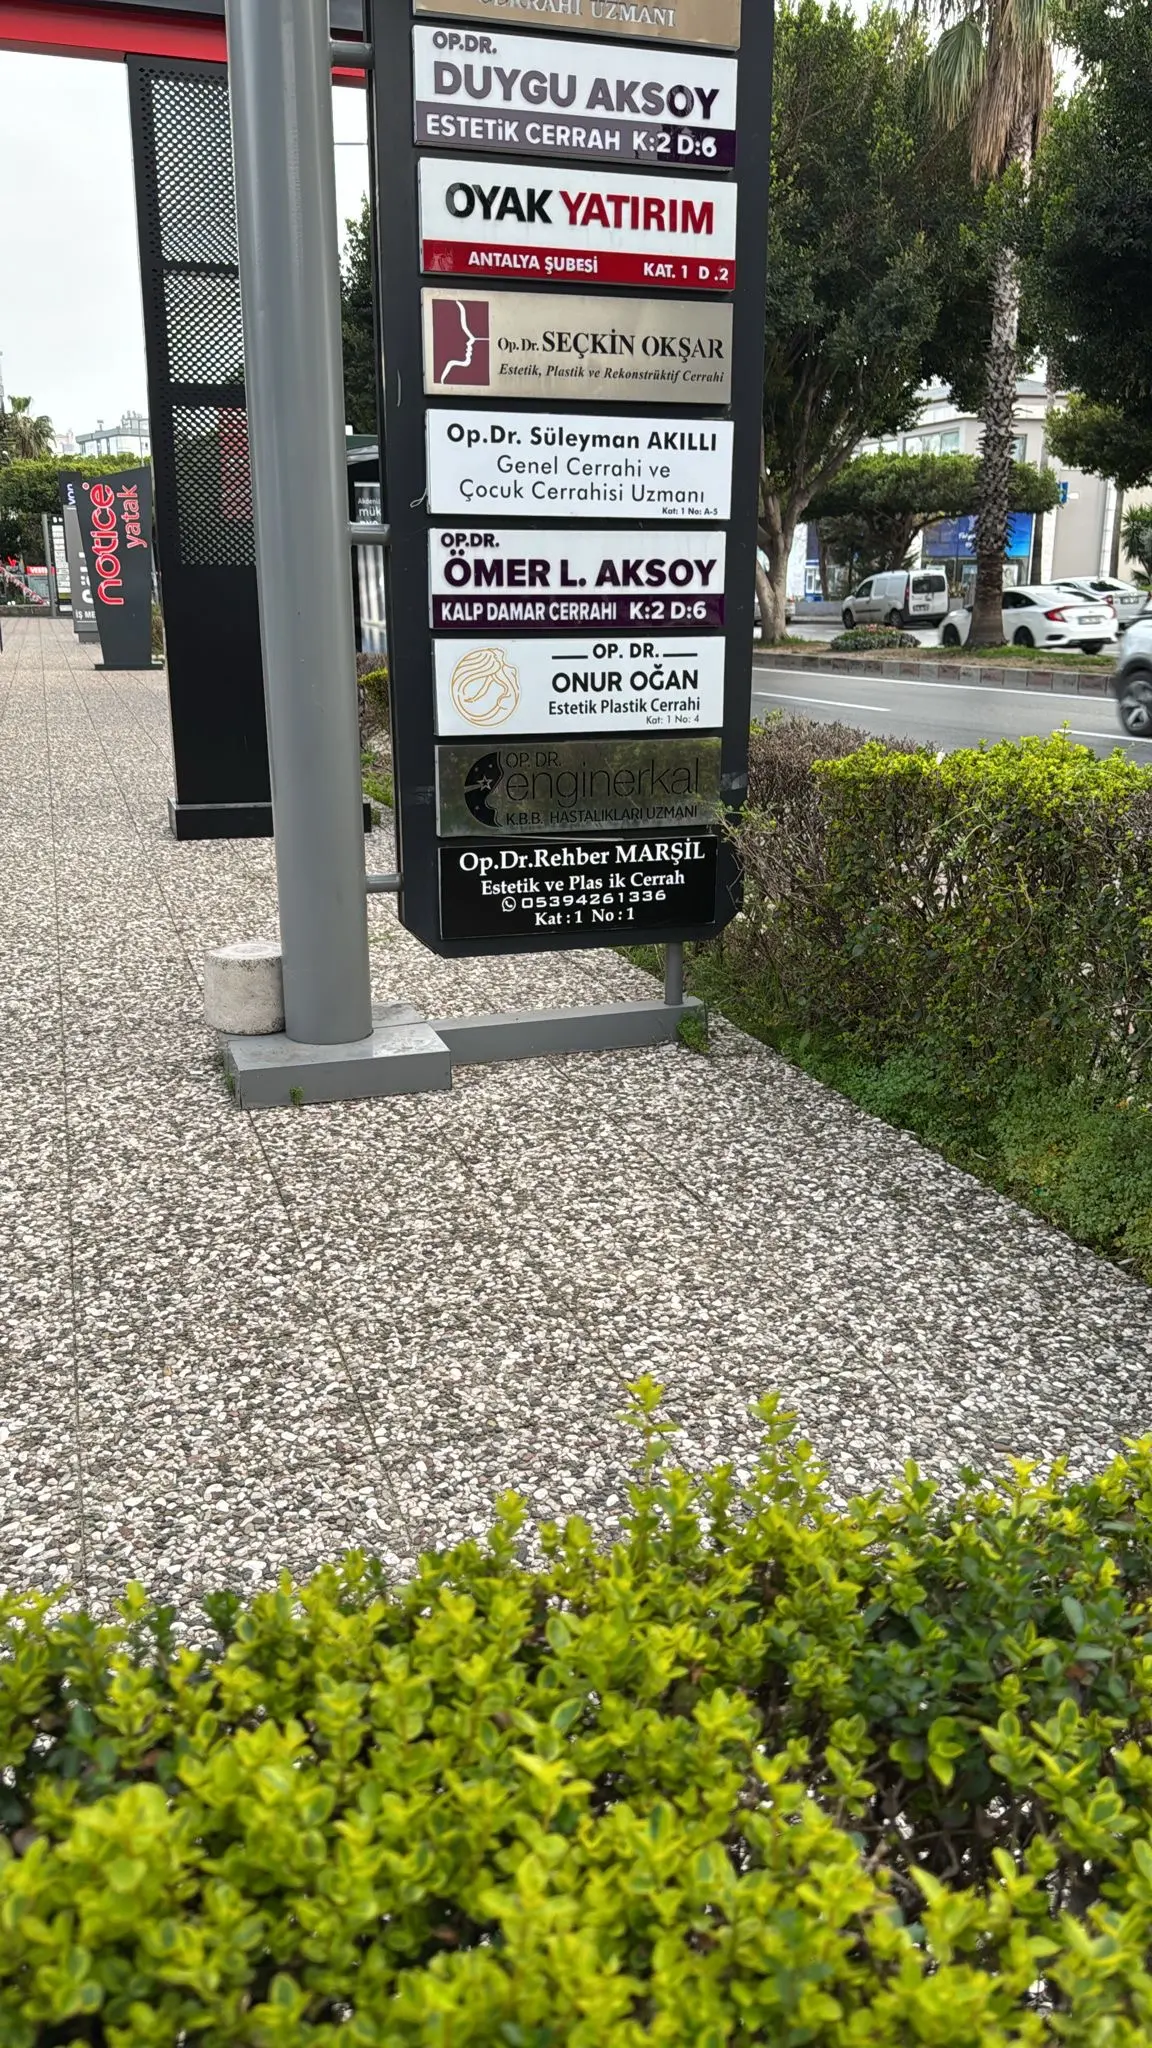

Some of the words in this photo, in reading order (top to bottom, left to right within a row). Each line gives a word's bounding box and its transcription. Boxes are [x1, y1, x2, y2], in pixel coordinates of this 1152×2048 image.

[591, 2, 677, 27] UZMANI
[432, 30, 497, 54] OP.DR.
[433, 60, 577, 108] DUYGU
[586, 77, 720, 120] AKSOY
[525, 125, 621, 151] CERRAH
[632, 130, 671, 153] K:2
[677, 134, 717, 158] D:6
[445, 182, 553, 224] OYAK
[559, 190, 714, 235] YATIRIM
[467, 251, 540, 270] ANTALYA
[544, 255, 598, 275] ŞUBESİ
[643, 262, 676, 279] KAT.
[681, 265, 688, 279] 1
[542, 328, 635, 359] SEÇKİN
[641, 335, 725, 363] OKŞAR
[499, 363, 542, 377] Estetik,
[546, 364, 585, 378] Plastik
[588, 369, 600, 379] ve
[604, 366, 681, 384] Rekonstrüktif
[683, 371, 725, 383] Cerrahi
[446, 423, 522, 448] Op.Dr.
[530, 425, 640, 453] Süleyman
[647, 431, 718, 452] AKILLI
[496, 454, 558, 475] Genel
[566, 457, 641, 478] Cerrahi
[649, 465, 671, 478] ve
[459, 478, 524, 502] Çocuk
[531, 480, 624, 502] Cerrahisi
[631, 483, 705, 504] Uzmanı
[117, 484, 148, 549] yatak
[90, 483, 125, 606] notice
[440, 533, 500, 548] OP.DR.
[443, 549, 551, 588] ÖMER
[560, 559, 587, 588] L.
[595, 558, 718, 588] AKSOY
[441, 603, 483, 622] KALP
[486, 602, 546, 621] DAMAR
[549, 602, 617, 621] CERRAHI
[629, 601, 665, 620] K:2
[670, 601, 707, 620] D:6
[592, 643, 623, 659] OP.
[629, 643, 660, 658] DR.
[551, 671, 623, 693] ONUR
[629, 664, 699, 691] OĞAN
[548, 699, 597, 715] Estetik
[600, 698, 648, 714] Plastik
[650, 696, 700, 712] Cerrahi
[506, 757, 699, 809] enginerkal
[550, 807, 643, 824] HASTALIKLARI
[646, 805, 697, 820] UZMANI
[614, 838, 706, 865] MARŞİL
[481, 877, 540, 895] Estetik
[544, 880, 564, 892] ve
[568, 875, 603, 890] Plas
[630, 869, 685, 887] Cerrah
[521, 889, 667, 909] 05394261336
